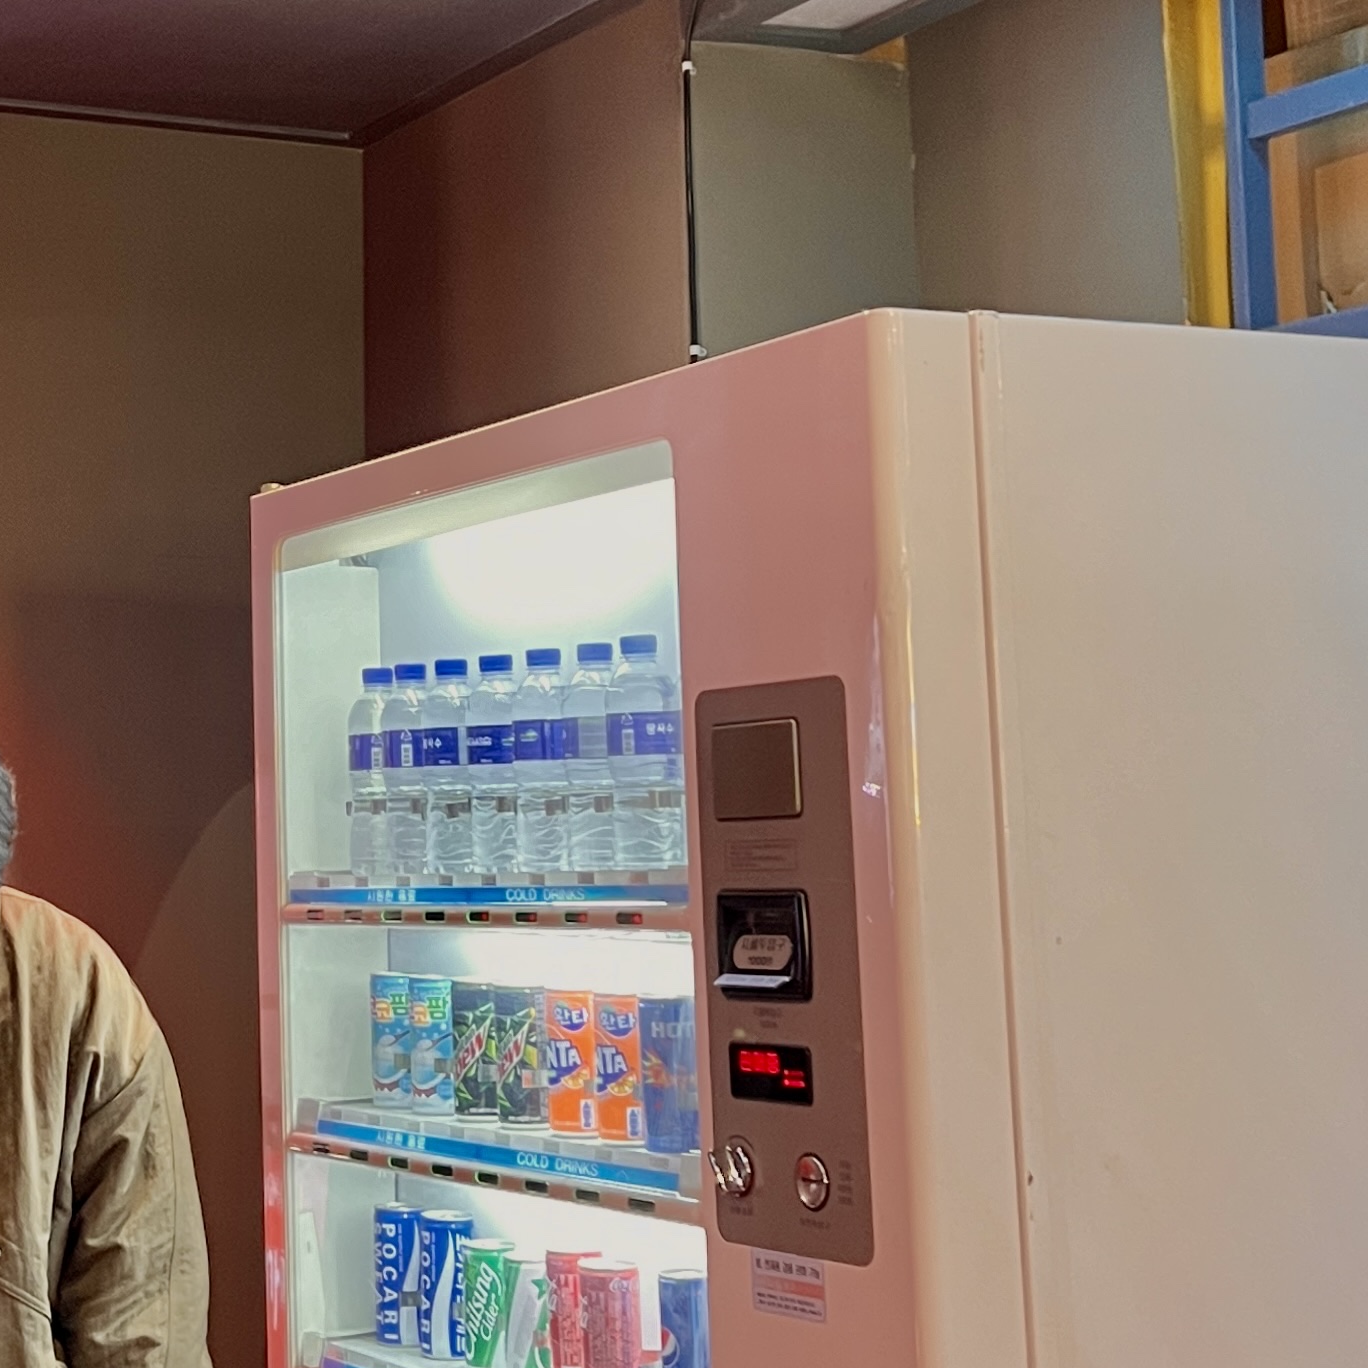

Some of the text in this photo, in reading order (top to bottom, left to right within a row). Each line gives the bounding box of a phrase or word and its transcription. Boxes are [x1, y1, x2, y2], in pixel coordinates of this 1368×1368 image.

[505, 888, 585, 902] COLD DRINKS
[546, 1040, 581, 1068] NTA
[596, 1046, 627, 1074] NTA
[516, 1151, 599, 1177] COLD DRINKS
[382, 1223, 399, 1340] POCARI
[421, 1230, 431, 1350] POCARI
[480, 1293, 500, 1341] Cider
